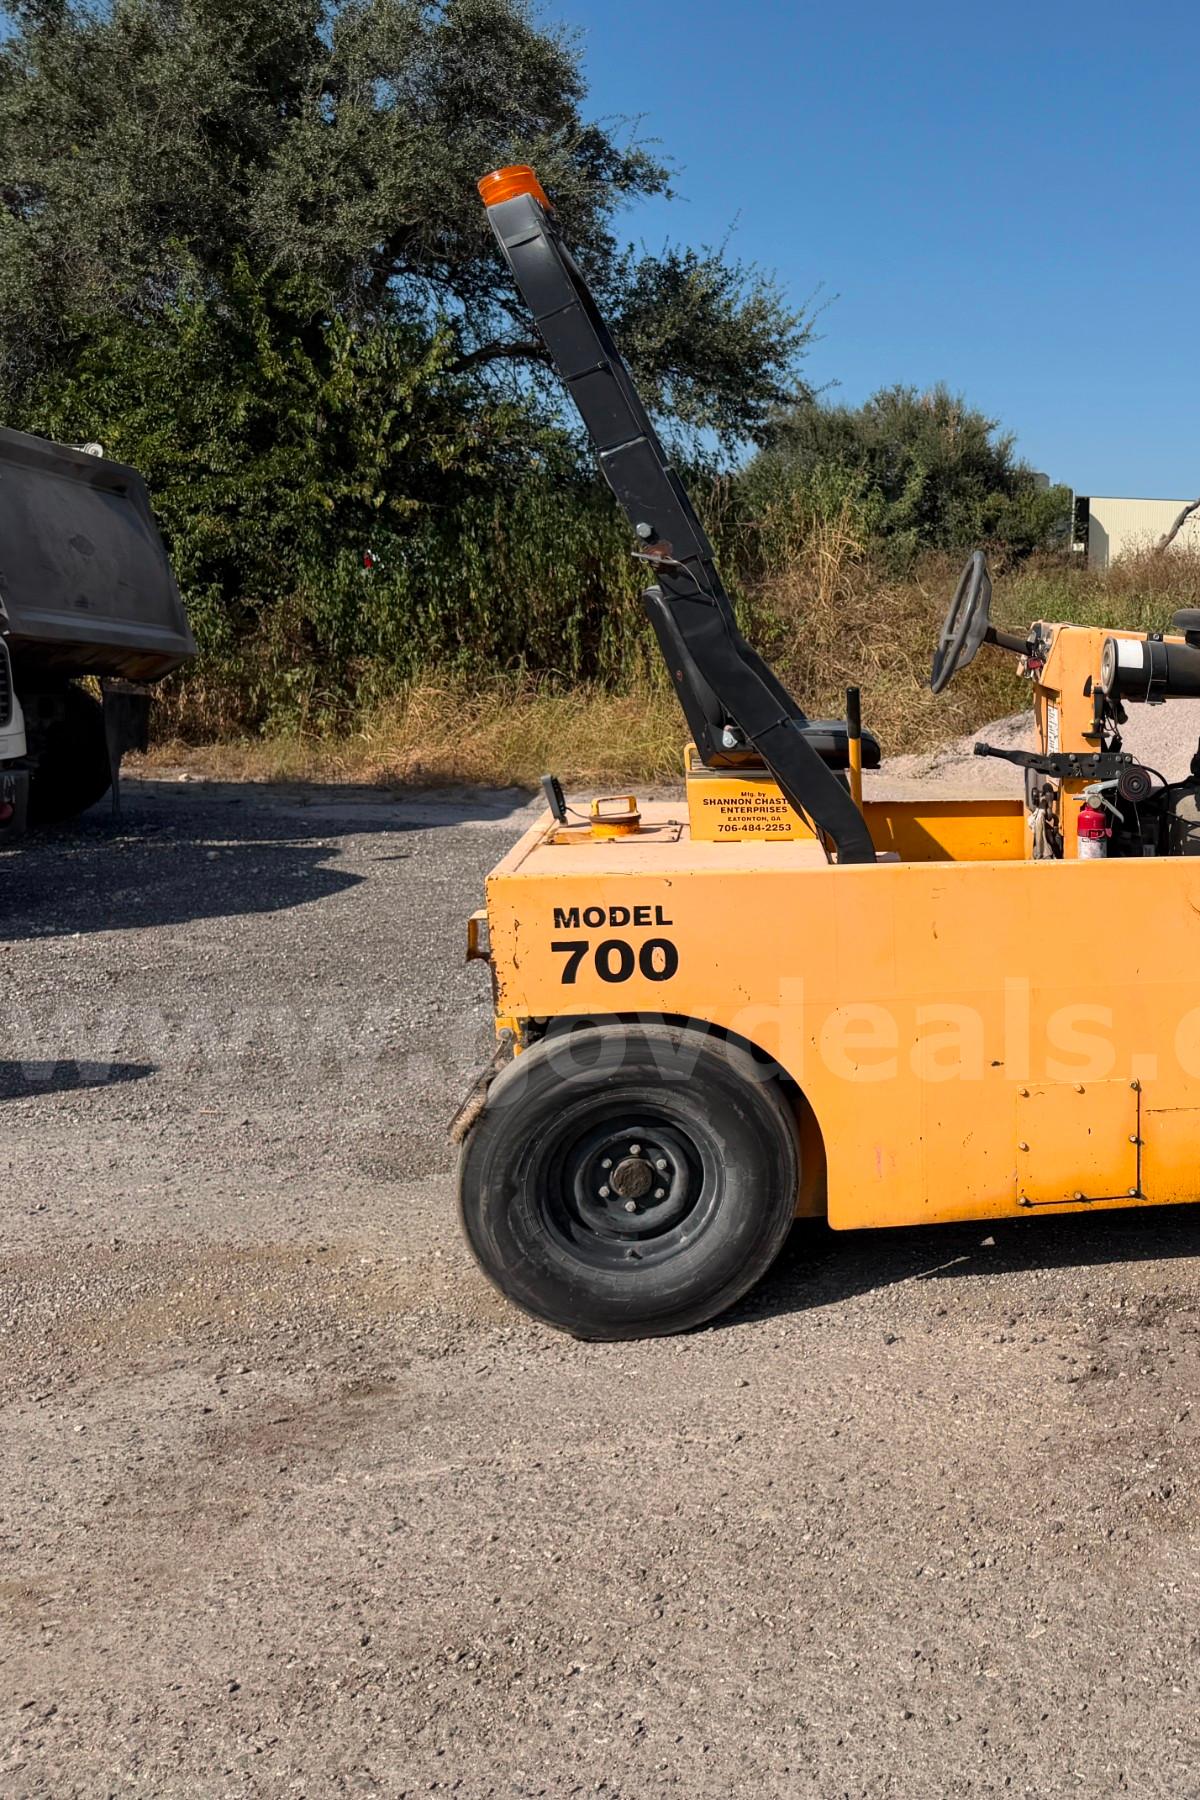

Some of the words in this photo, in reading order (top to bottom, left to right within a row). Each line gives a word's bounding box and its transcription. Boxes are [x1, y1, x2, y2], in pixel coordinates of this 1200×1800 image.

[703, 798, 752, 806] SHANNON
[718, 824, 791, 832] 706-484-2253
[553, 905, 673, 928] MODEL
[551, 938, 679, 984] 700
